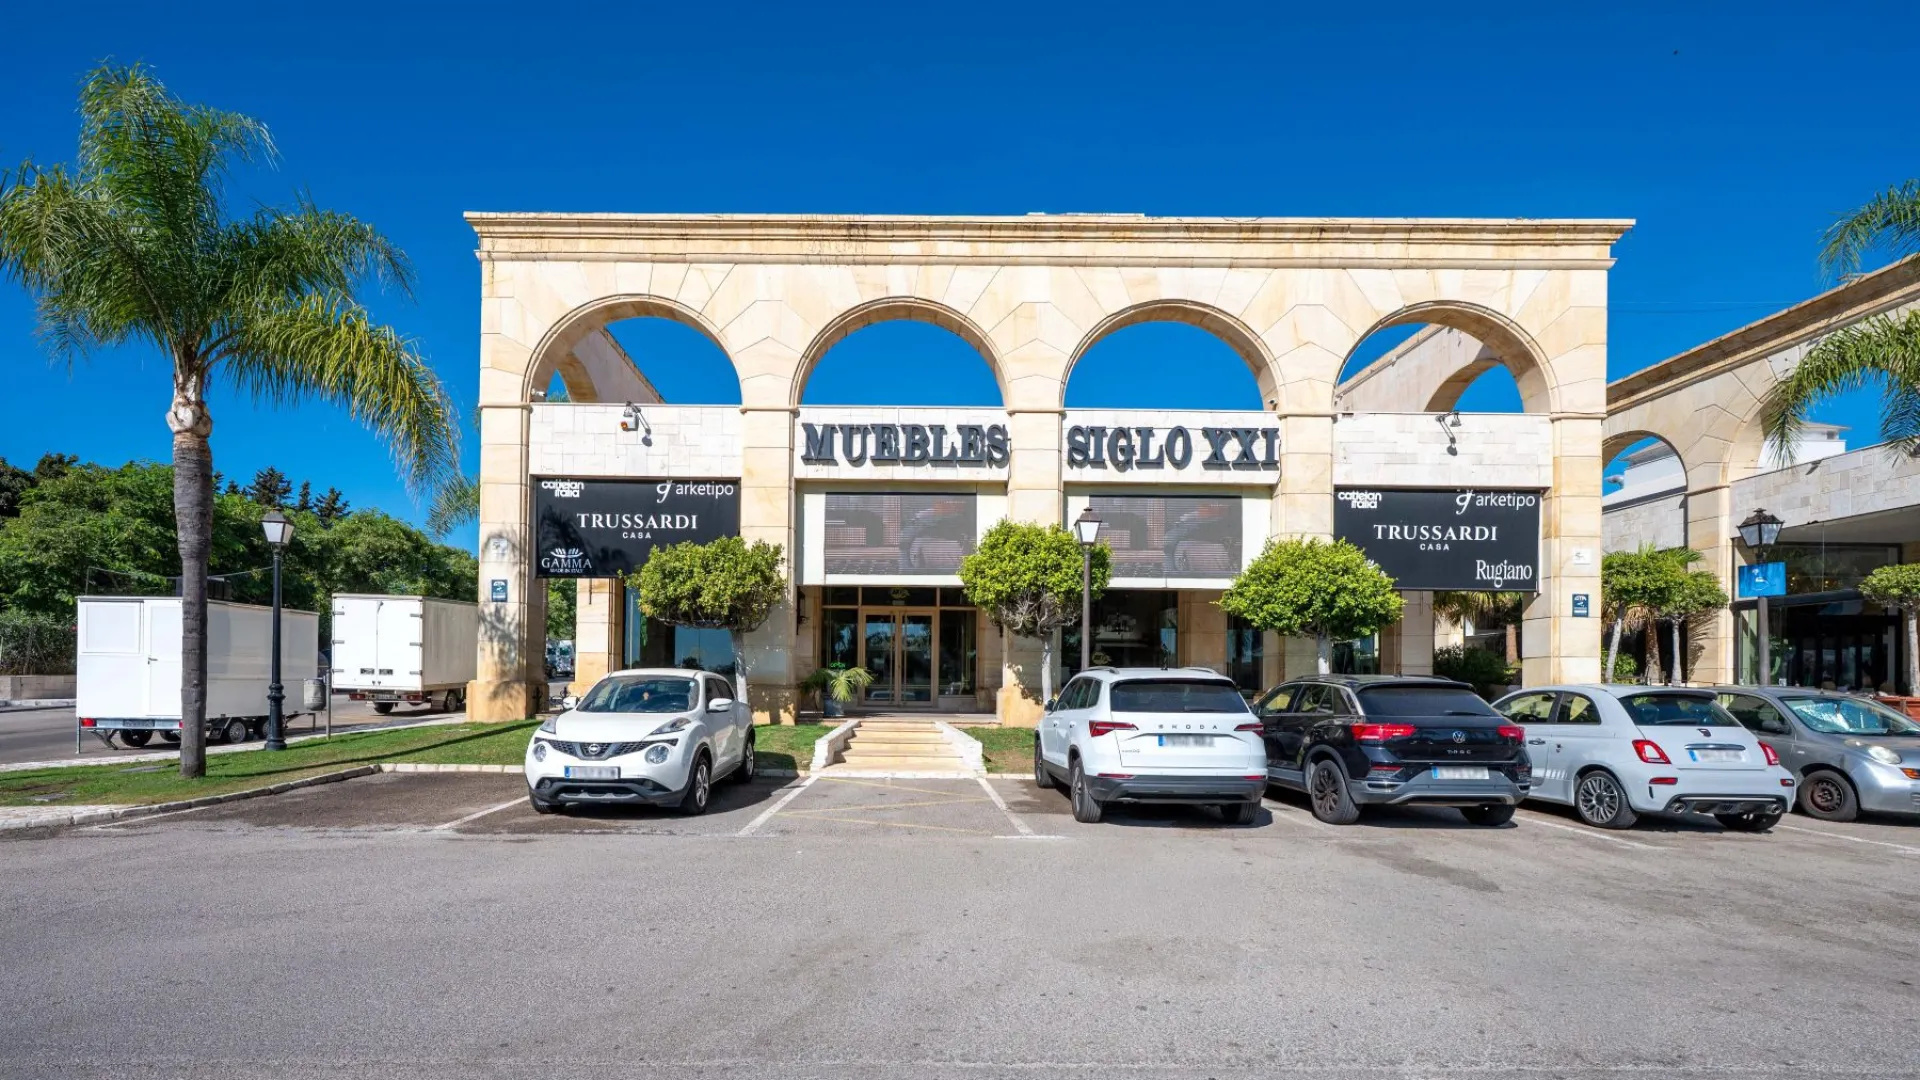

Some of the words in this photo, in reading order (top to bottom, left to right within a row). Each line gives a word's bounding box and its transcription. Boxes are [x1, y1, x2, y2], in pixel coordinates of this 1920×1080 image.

[800, 422, 1010, 466] MUEBLES
[1067, 425, 1194, 470] SIGLO
[1201, 426, 1280, 470] XXI
[675, 481, 734, 499] arketipo
[1475, 492, 1536, 511] arketipo
[576, 513, 698, 529] TRUSSARDI
[1373, 524, 1498, 541] TRUSSARDI
[1419, 543, 1450, 551] CASA
[541, 557, 593, 569] GAMMA
[1475, 559, 1533, 589] Rugiano
